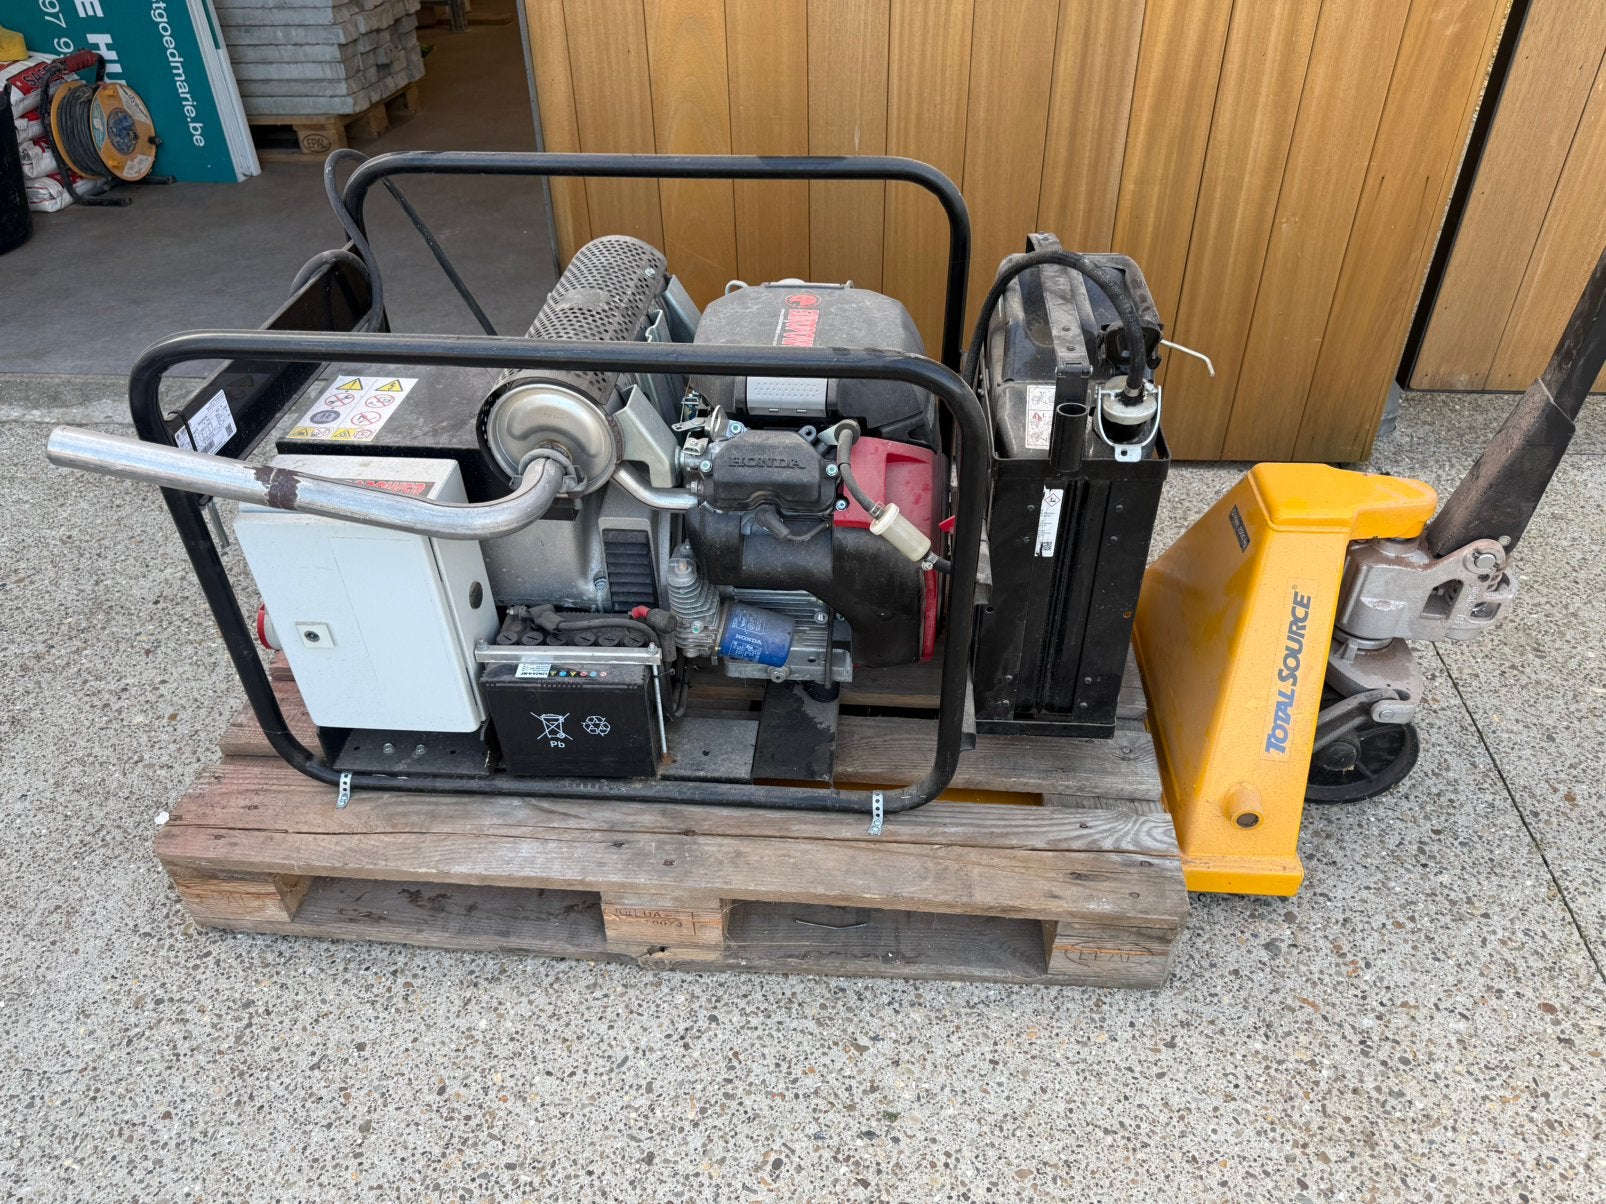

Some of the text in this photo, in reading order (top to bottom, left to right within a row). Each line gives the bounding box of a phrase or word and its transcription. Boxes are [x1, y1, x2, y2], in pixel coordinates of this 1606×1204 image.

[54, 37, 75, 59] 9
[151, 0, 205, 147] tgoedmarie.be
[727, 457, 806, 469] HONDA
[735, 633, 763, 645] HONDA
[550, 740, 566, 749] Pb
